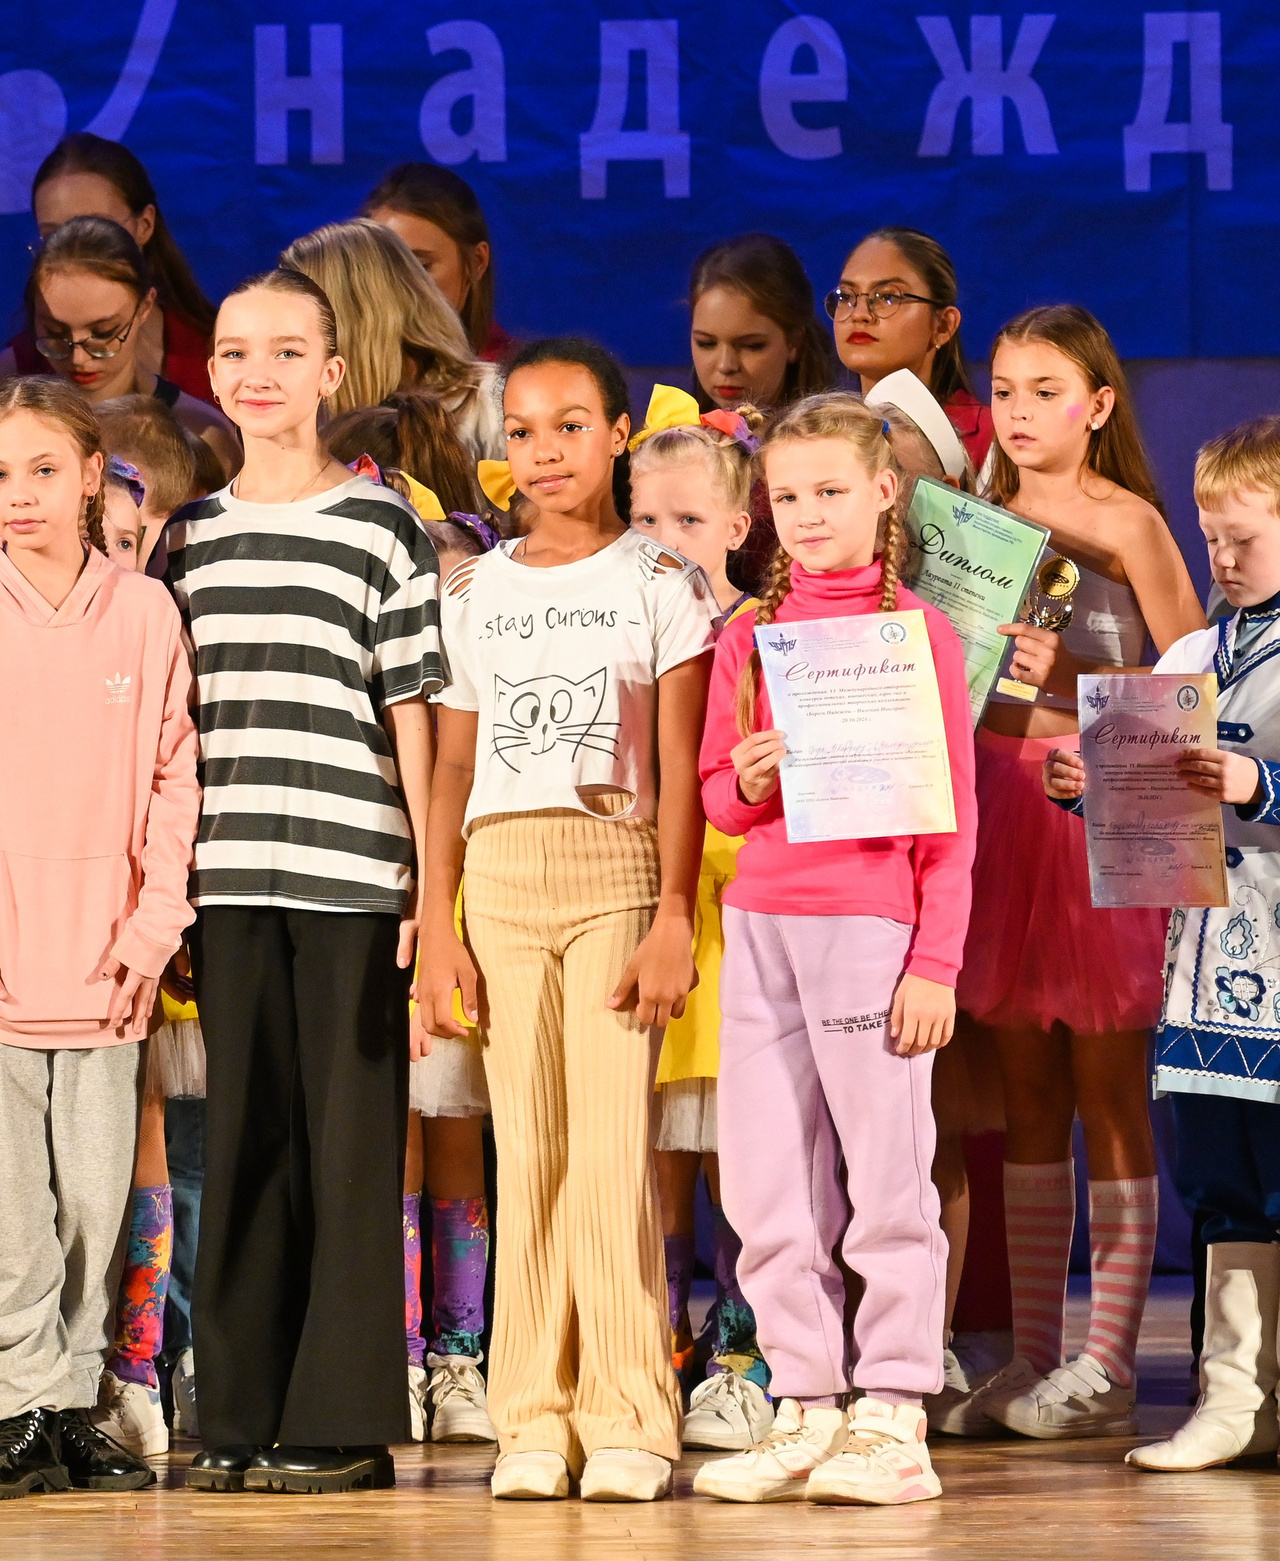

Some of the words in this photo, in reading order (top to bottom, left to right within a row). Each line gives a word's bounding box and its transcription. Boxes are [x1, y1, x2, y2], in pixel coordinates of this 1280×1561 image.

[909, 523, 1014, 590] Диплом
[485, 613, 534, 639] stay
[777, 658, 917, 684] Сертификат
[1089, 722, 1201, 750] Сертификат
[843, 1026, 854, 1034] TO
[856, 1020, 883, 1031] TAKE
[844, 1016, 859, 1024] ONE
[859, 1014, 871, 1022] BE
[873, 1009, 888, 1019] THE
